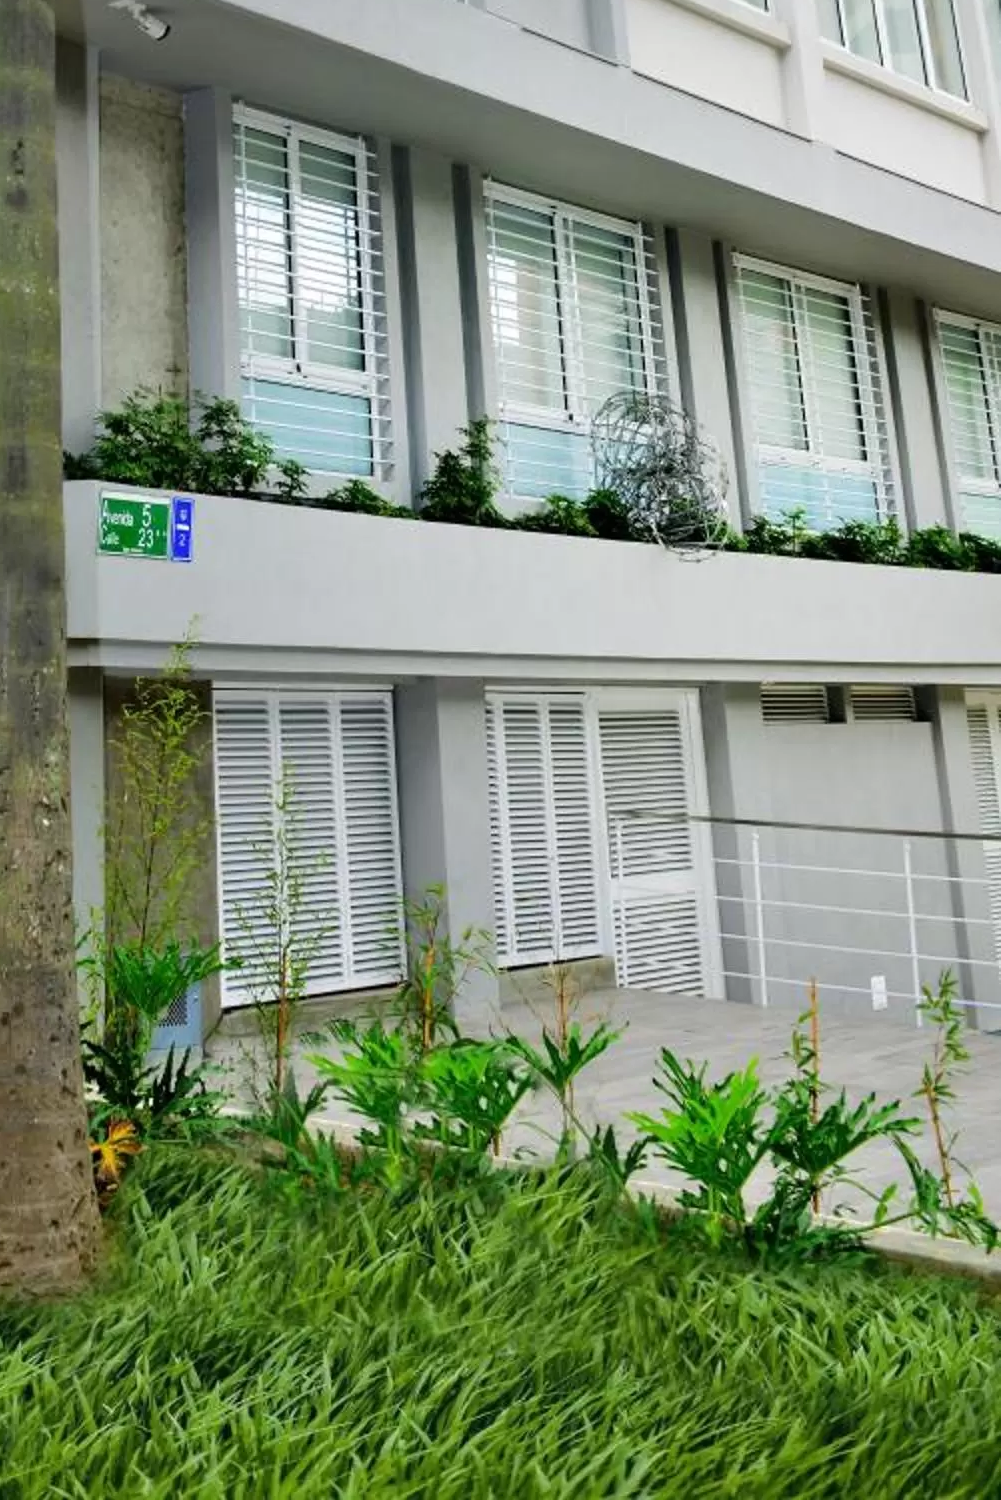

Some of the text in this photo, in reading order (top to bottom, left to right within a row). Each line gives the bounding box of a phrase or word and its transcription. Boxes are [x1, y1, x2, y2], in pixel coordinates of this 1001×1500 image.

[102, 500, 152, 527] Avenida 5
[102, 524, 154, 548] Calle 23
